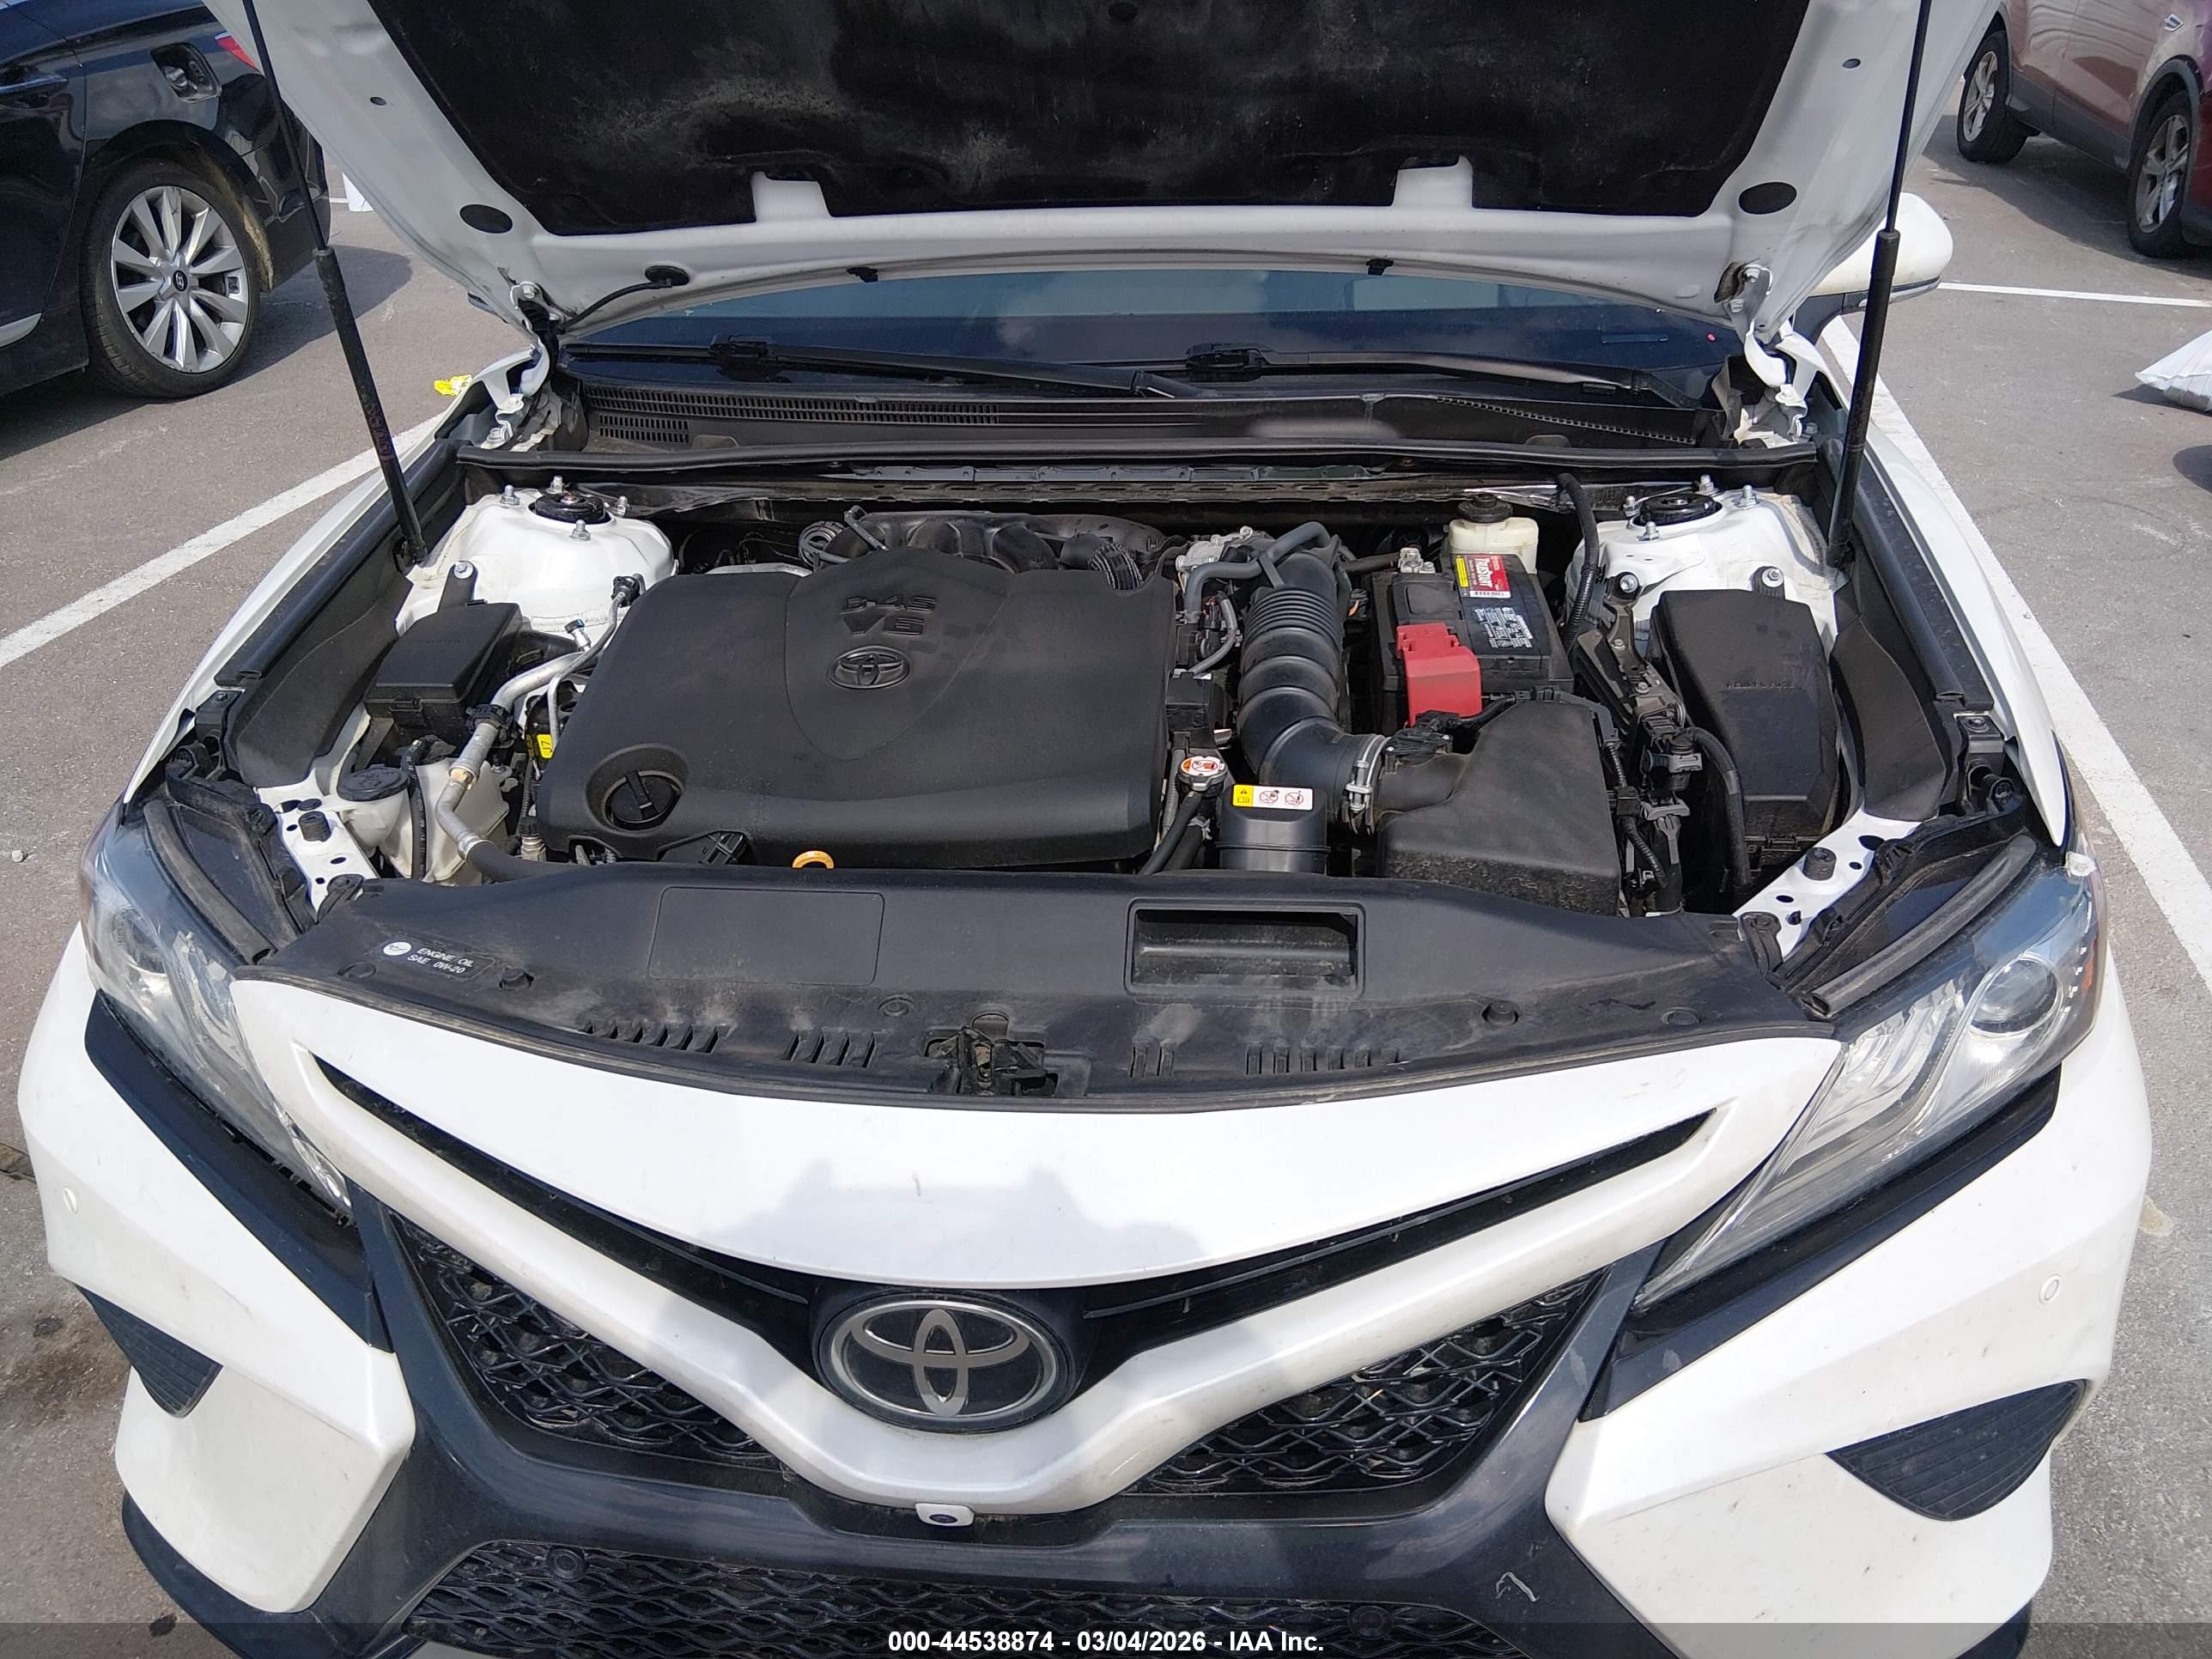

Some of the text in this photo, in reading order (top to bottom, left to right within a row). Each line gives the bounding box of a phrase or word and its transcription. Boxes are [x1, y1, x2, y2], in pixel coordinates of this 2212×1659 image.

[842, 595, 937, 613] D-4S
[844, 615, 926, 636] V6
[407, 954, 466, 974] SAE 0W-20
[416, 948, 474, 968] ENGINE OIL
